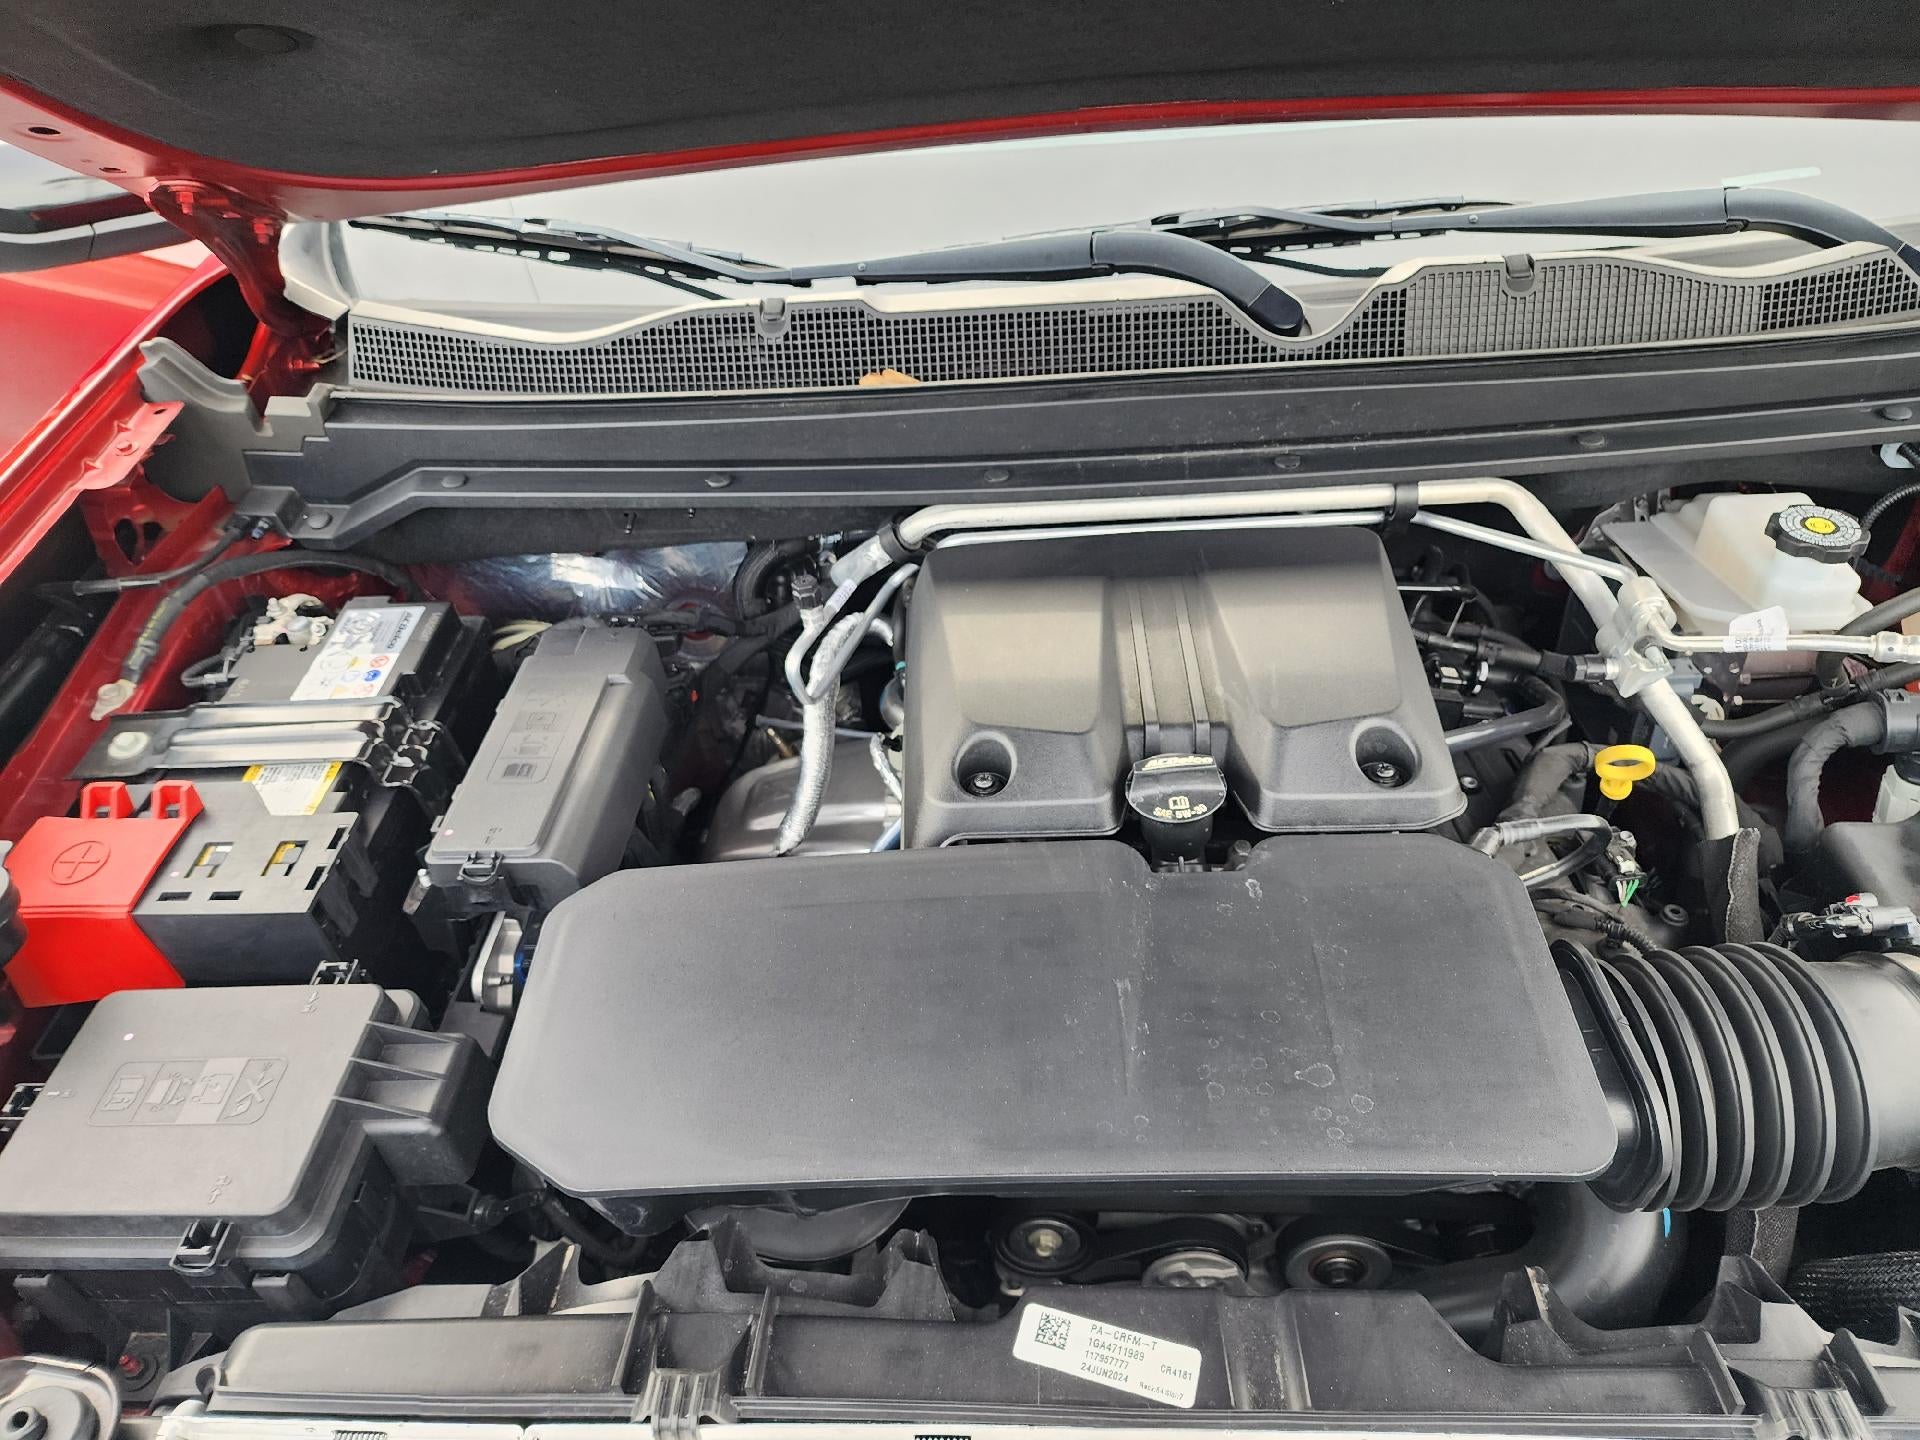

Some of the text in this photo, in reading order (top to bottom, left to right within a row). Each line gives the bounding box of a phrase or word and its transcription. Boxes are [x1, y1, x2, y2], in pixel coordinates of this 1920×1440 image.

[1141, 756, 1213, 771] ACDelco
[1153, 803, 1208, 819] SAE 5W-30
[1090, 1324, 1158, 1351] PA-CRFM-T
[1088, 1337, 1145, 1362] 1GA4711989
[1081, 1362, 1129, 1383] 24JUN2024
[1160, 1364, 1193, 1381] CR4181
